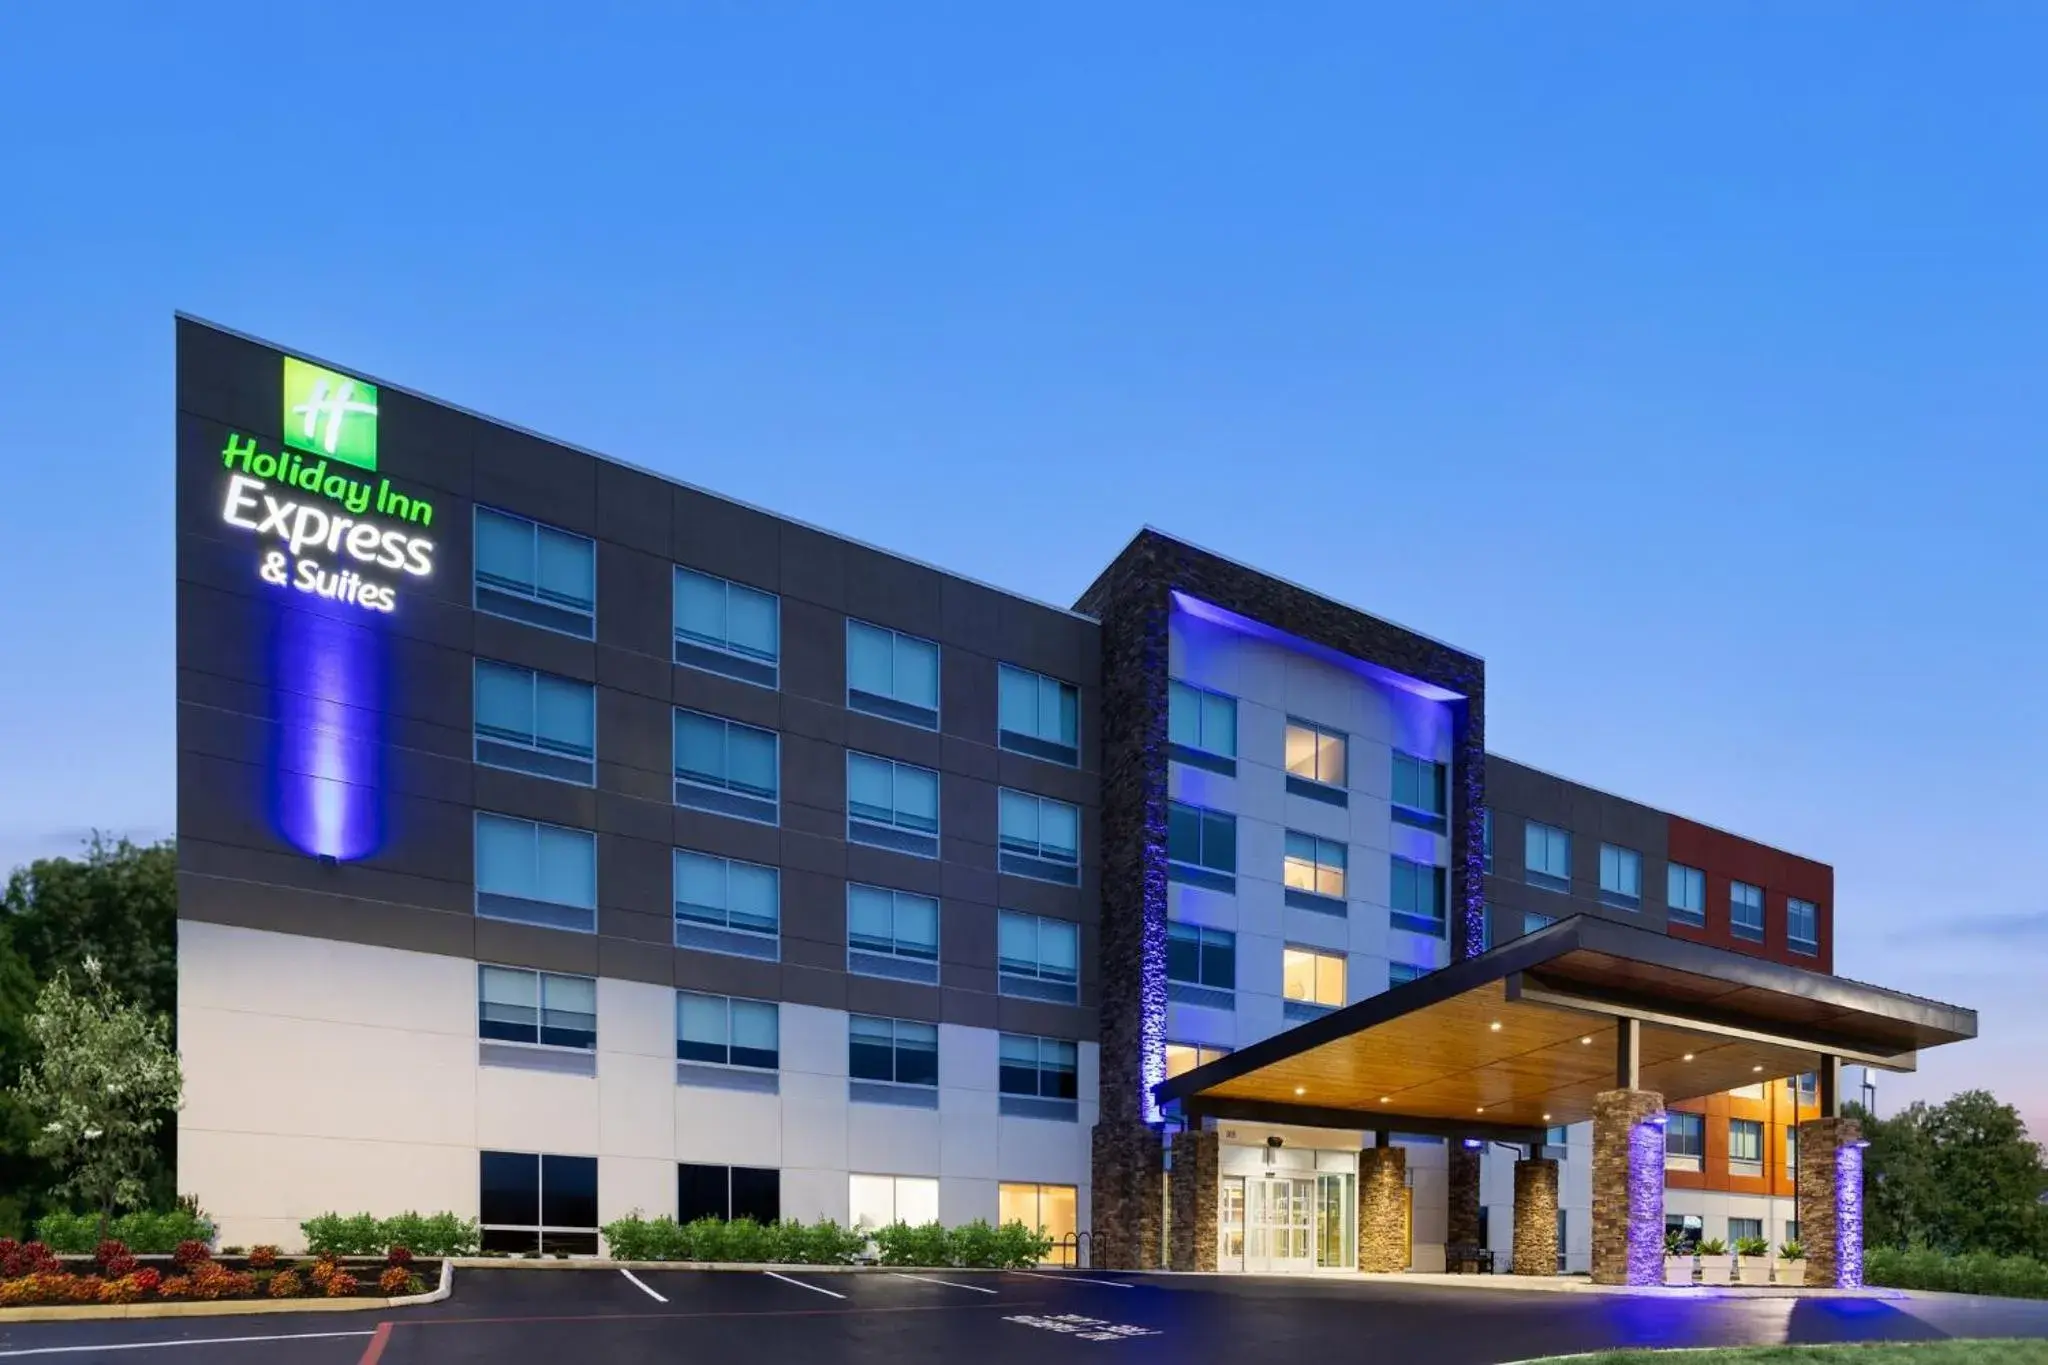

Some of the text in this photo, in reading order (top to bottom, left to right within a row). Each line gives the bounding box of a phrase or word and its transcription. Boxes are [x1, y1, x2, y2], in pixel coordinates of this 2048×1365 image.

[222, 433, 433, 526] Holiday Inn
[222, 474, 433, 576] Express
[260, 551, 395, 613] & Suites
